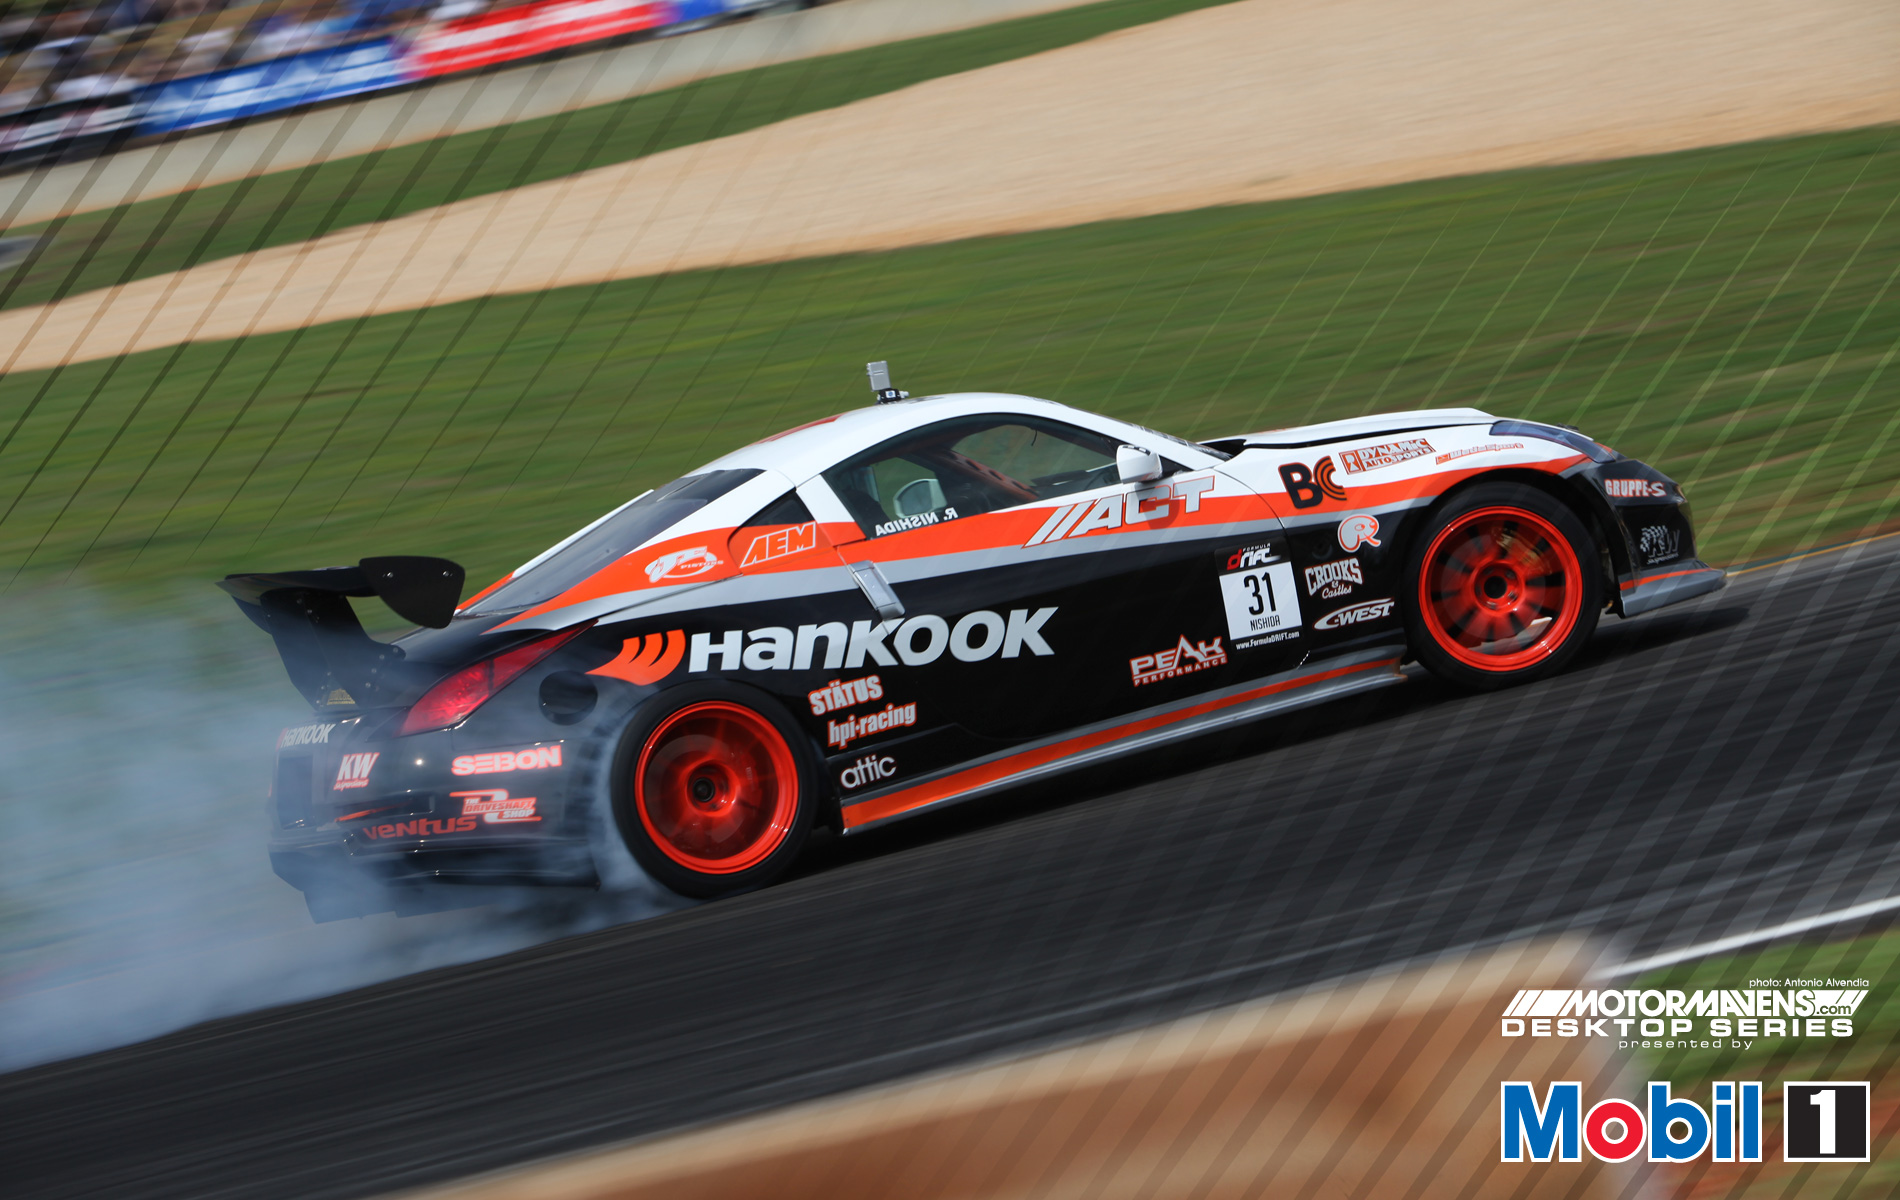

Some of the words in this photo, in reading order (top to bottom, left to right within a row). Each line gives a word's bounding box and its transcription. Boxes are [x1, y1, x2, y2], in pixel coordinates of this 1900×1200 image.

[1604, 478, 1667, 498] GRUPPE-S
[739, 521, 817, 568] AEM
[1242, 542, 1271, 553] FORMULA
[1304, 557, 1364, 596] CROOKS
[1331, 580, 1339, 588] &
[1243, 572, 1276, 616] 31
[1321, 584, 1352, 599] Castles
[1250, 615, 1281, 632] NISHIDA
[1236, 631, 1300, 650] www.FormulaDRIFT.com
[1129, 634, 1226, 676] PEAK
[1133, 656, 1228, 687] PERFORMANCE
[808, 674, 883, 716] STÄTUS
[336, 752, 380, 782] KW
[452, 745, 563, 776] SEBON
[840, 754, 897, 789] attic
[464, 800, 535, 813] DRIVESHAFT
[465, 797, 481, 805] THE
[502, 808, 535, 819] SHOP
